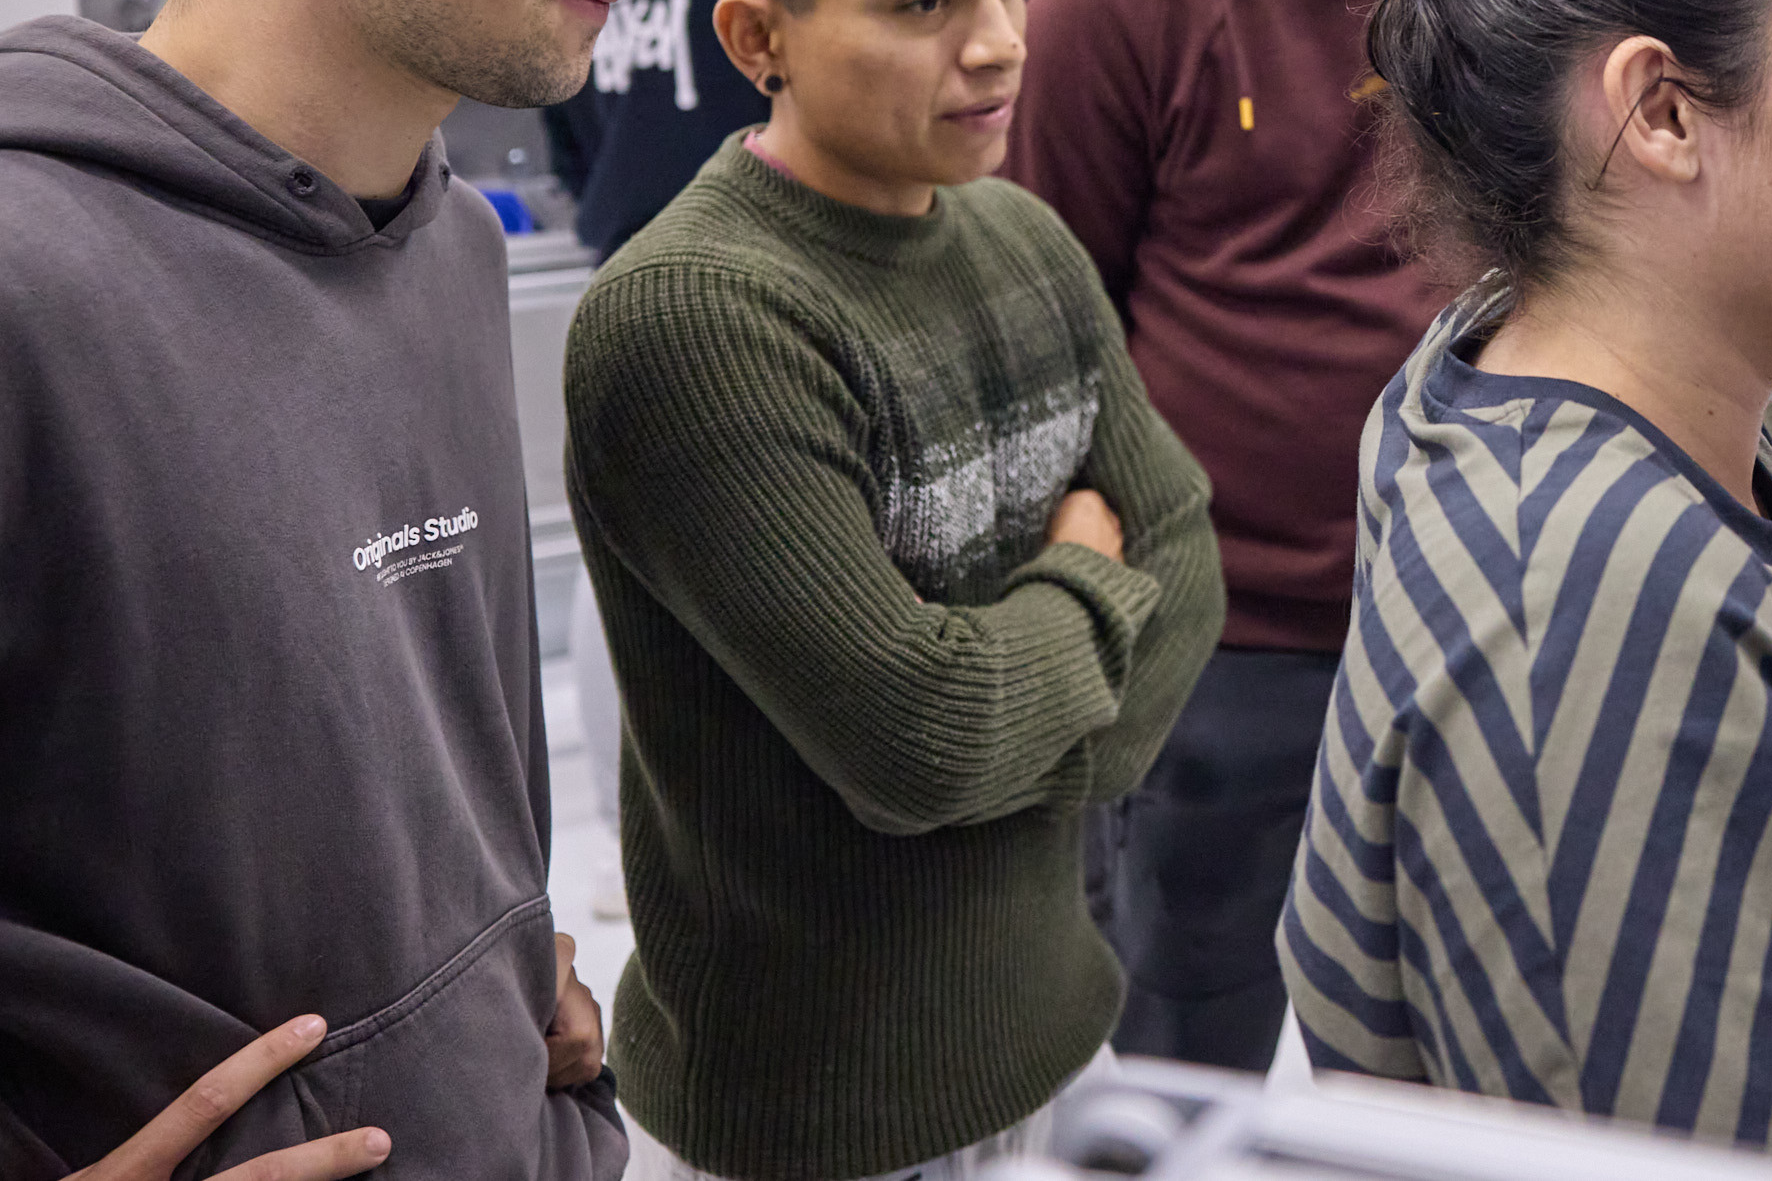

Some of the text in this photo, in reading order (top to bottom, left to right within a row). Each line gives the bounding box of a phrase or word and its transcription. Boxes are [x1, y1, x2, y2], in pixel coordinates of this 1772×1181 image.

[353, 506, 479, 572] Originals Studio
[405, 558, 453, 576] COPENHAGEN
